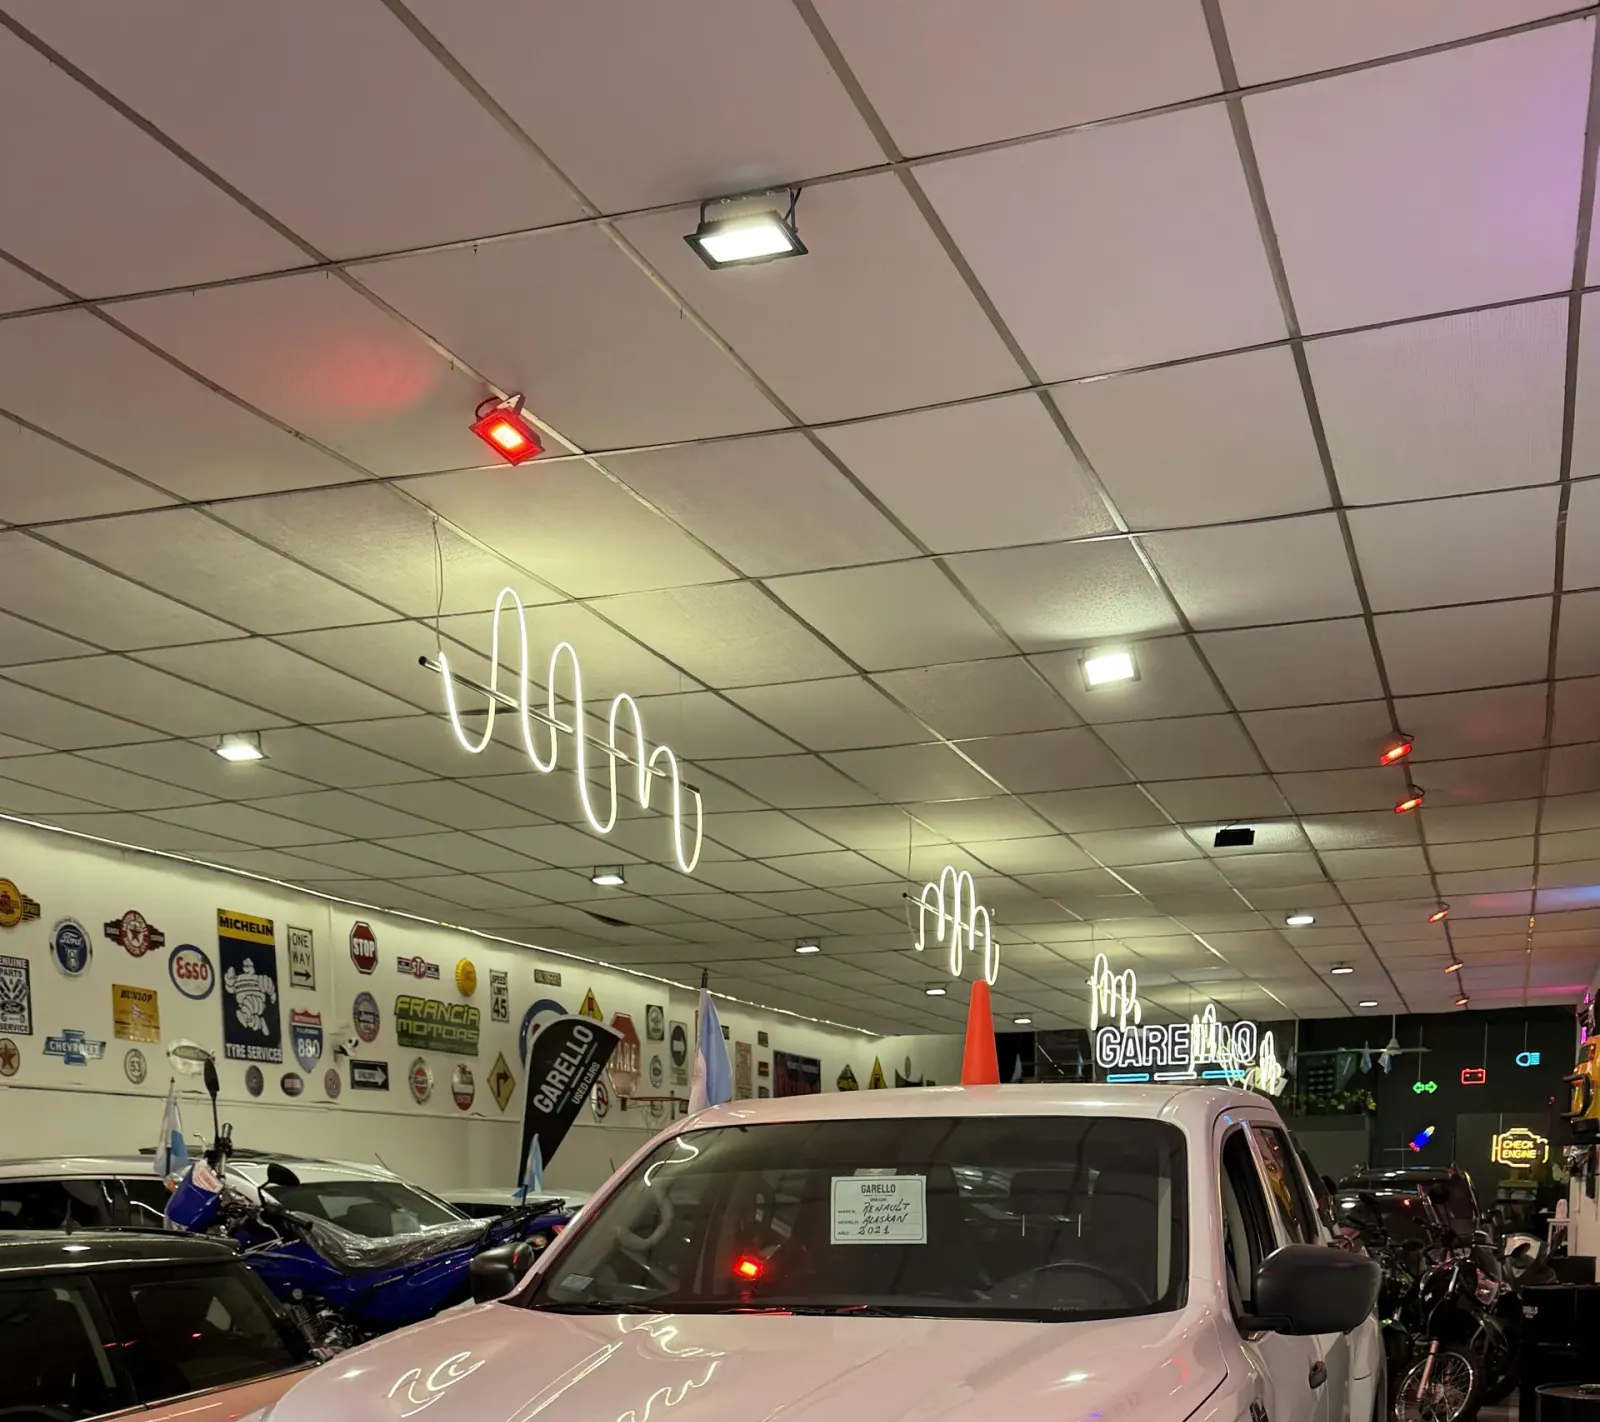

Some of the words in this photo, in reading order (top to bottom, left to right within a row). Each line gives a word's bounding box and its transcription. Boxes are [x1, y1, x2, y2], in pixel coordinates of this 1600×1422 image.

[220, 916, 274, 936] MICHELIN
[292, 933, 309, 948] ONE
[353, 938, 375, 958] STOP
[0, 956, 28, 969] ENUINE
[292, 952, 311, 966] WAY
[411, 957, 426, 975] STP
[492, 974, 507, 985] SPEED
[121, 989, 153, 1002] DUNLOP
[493, 986, 508, 997] LIMIT
[493, 997, 508, 1019] 45
[397, 1019, 479, 1043] MOTORS
[297, 1038, 320, 1058] 880
[1096, 1020, 1258, 1068] GARELLO
[226, 1043, 246, 1059] TYRE
[247, 1045, 282, 1062] SERVICES
[129, 1060, 142, 1072] 53
[533, 1024, 594, 1114] GARELLO
[572, 1080, 589, 1105] USED
[584, 1061, 601, 1089] CARS
[1503, 1140, 1534, 1149] CHECK
[1502, 1149, 1537, 1159] ENGINE
[861, 1184, 896, 1194] GARELLO
[862, 1198, 910, 1217] RENAULT
[862, 1213, 909, 1228] ALASKAN
[858, 1225, 890, 1236] 2021
